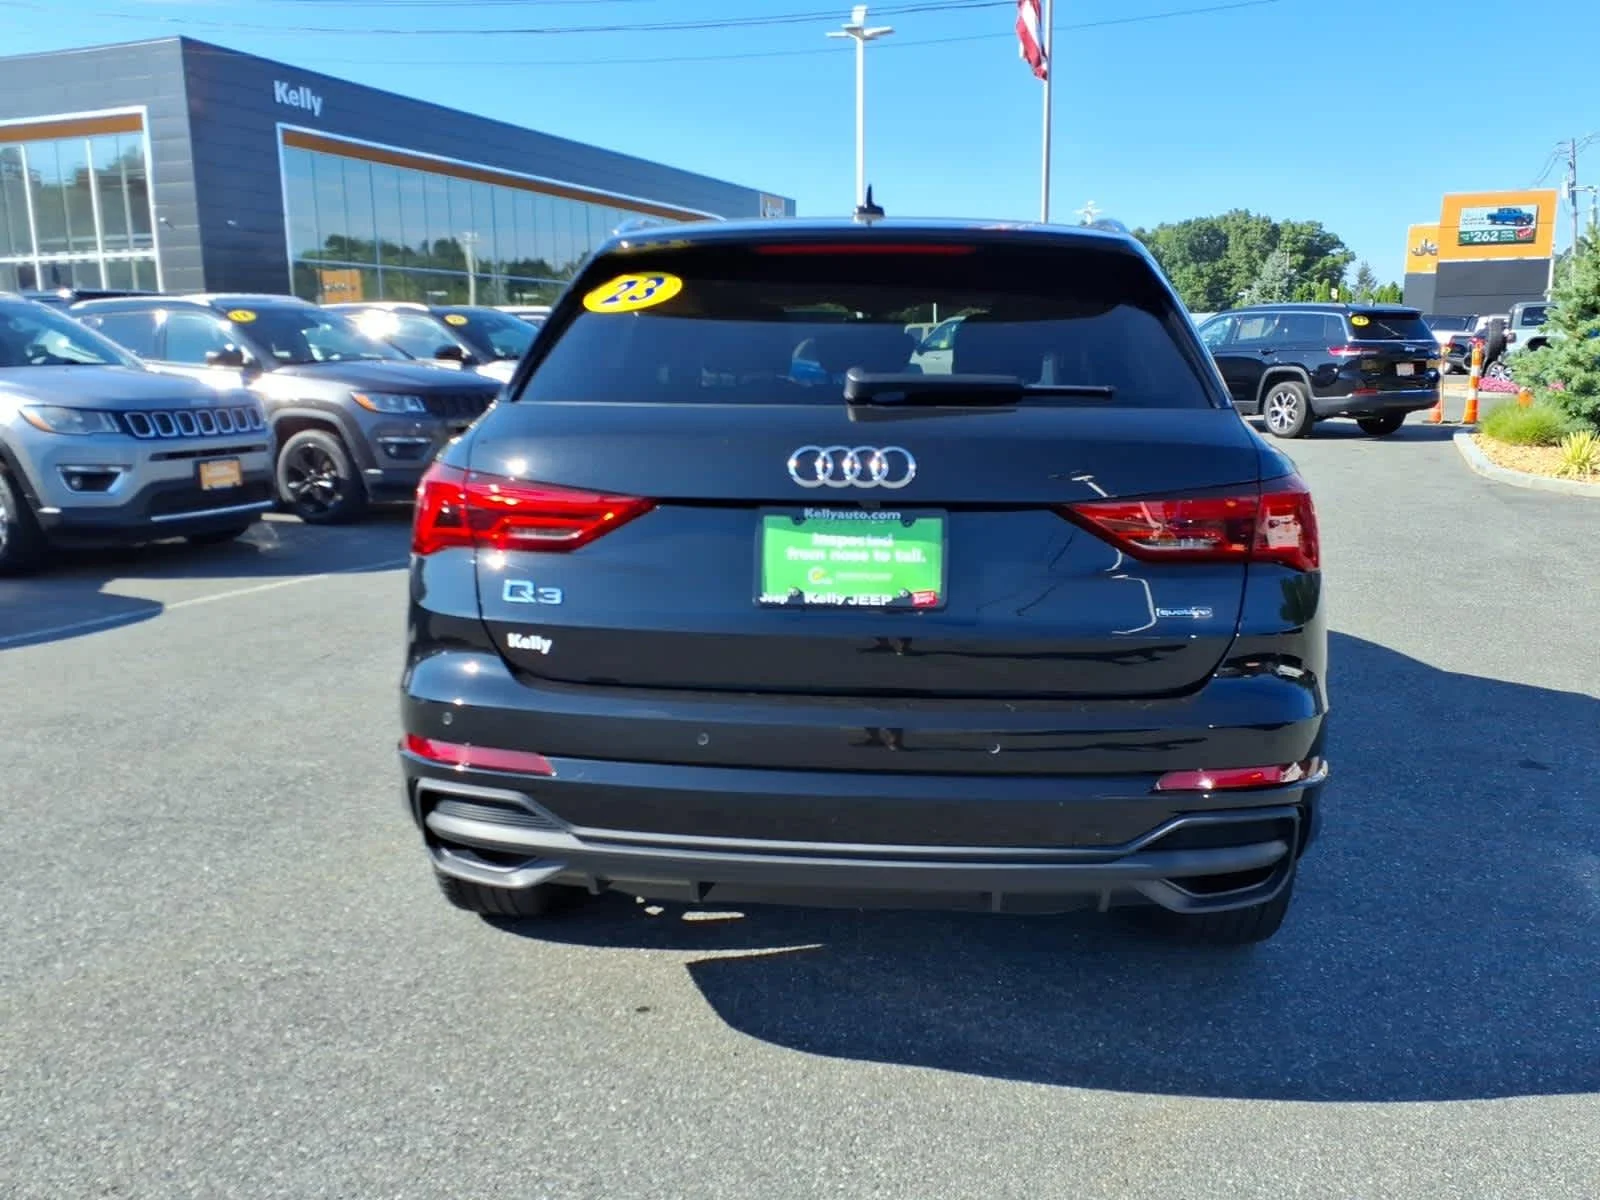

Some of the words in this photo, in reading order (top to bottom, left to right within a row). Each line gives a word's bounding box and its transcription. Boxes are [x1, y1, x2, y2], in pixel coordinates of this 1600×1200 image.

[273, 80, 323, 117] Kelly
[600, 276, 665, 305] 23
[804, 507, 901, 520] Kellyauto.com
[786, 547, 825, 561] from
[830, 550, 869, 561] nose
[873, 550, 891, 561] to
[503, 579, 562, 605] Q3
[804, 592, 847, 606] Kelly
[847, 594, 893, 606] JEEP
[507, 632, 553, 655] Kelly
